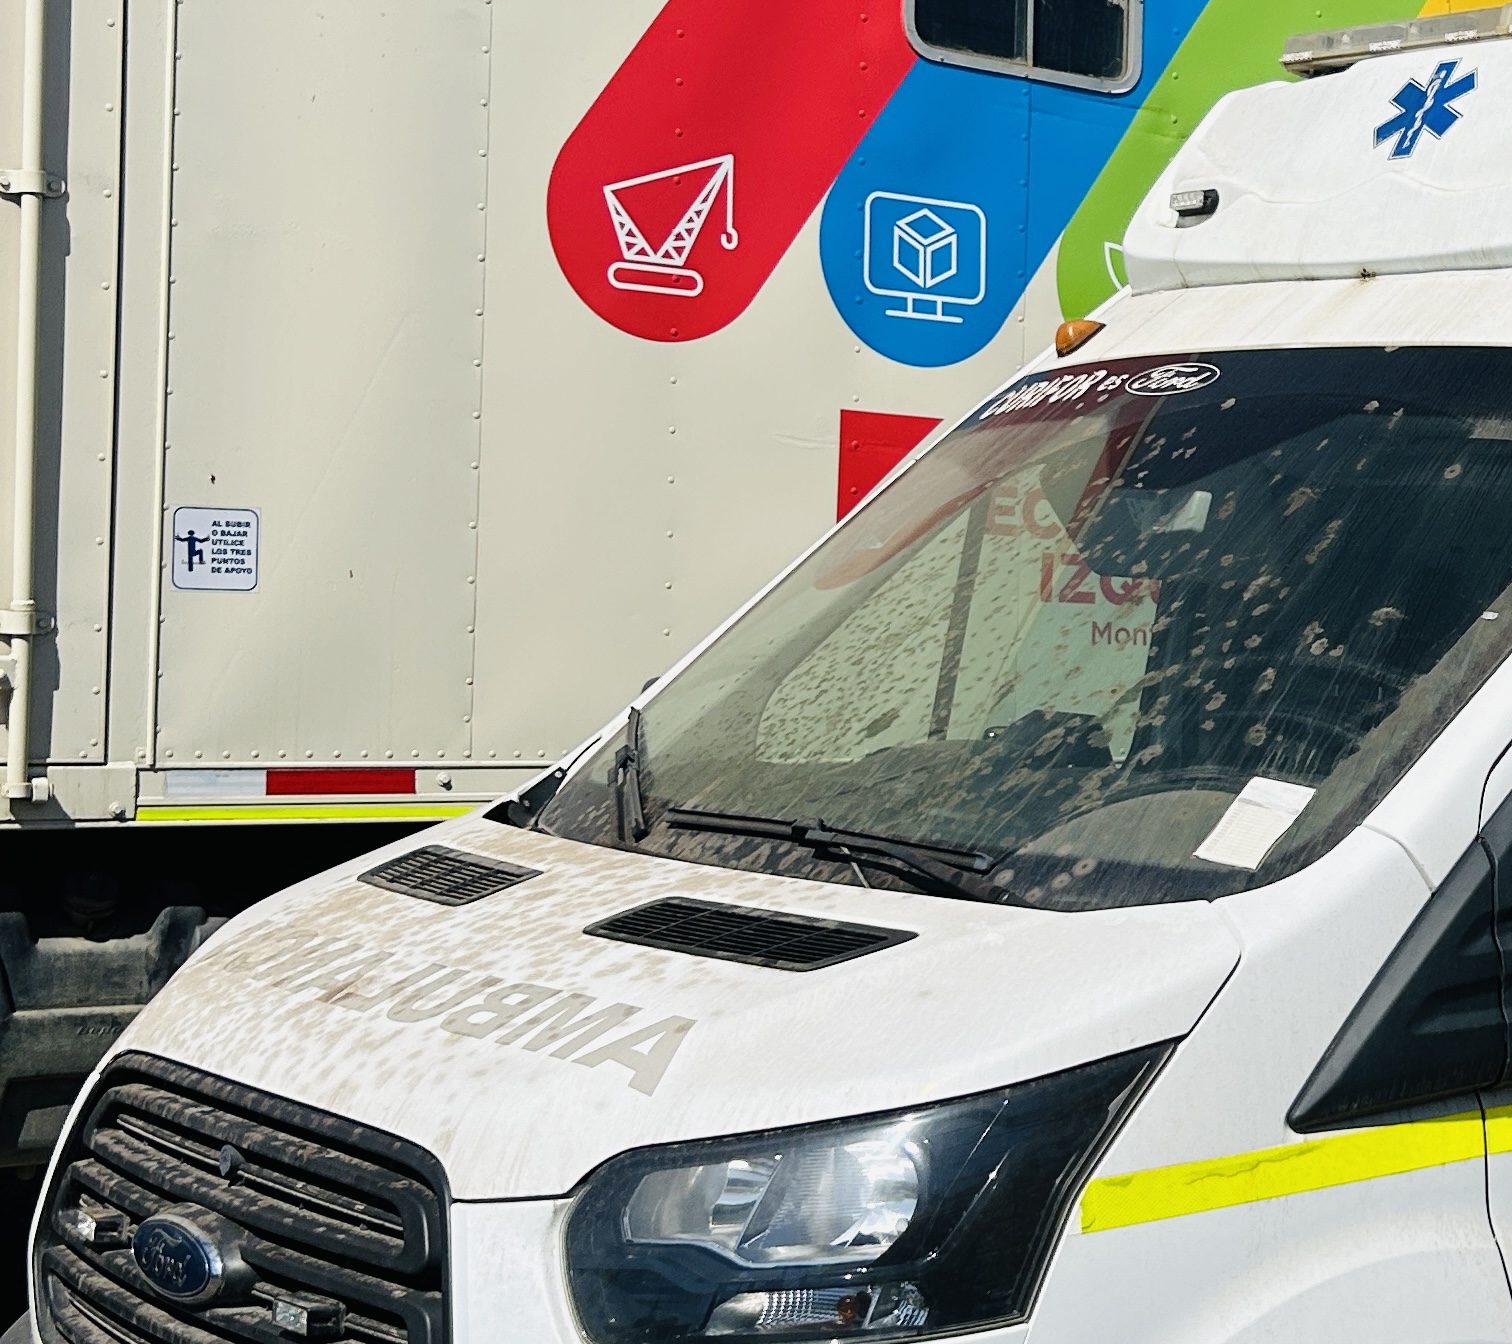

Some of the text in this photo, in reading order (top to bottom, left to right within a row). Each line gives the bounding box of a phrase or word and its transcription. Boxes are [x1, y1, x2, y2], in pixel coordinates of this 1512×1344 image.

[1130, 364, 1213, 392] Ford
[225, 520, 251, 528] SUBIR
[985, 485, 1062, 539] EC
[211, 557, 246, 565] PUNTOS
[1040, 552, 1162, 605] IZQ
[1091, 621, 1152, 646] Mon
[142, 1227, 192, 1287] Ford
